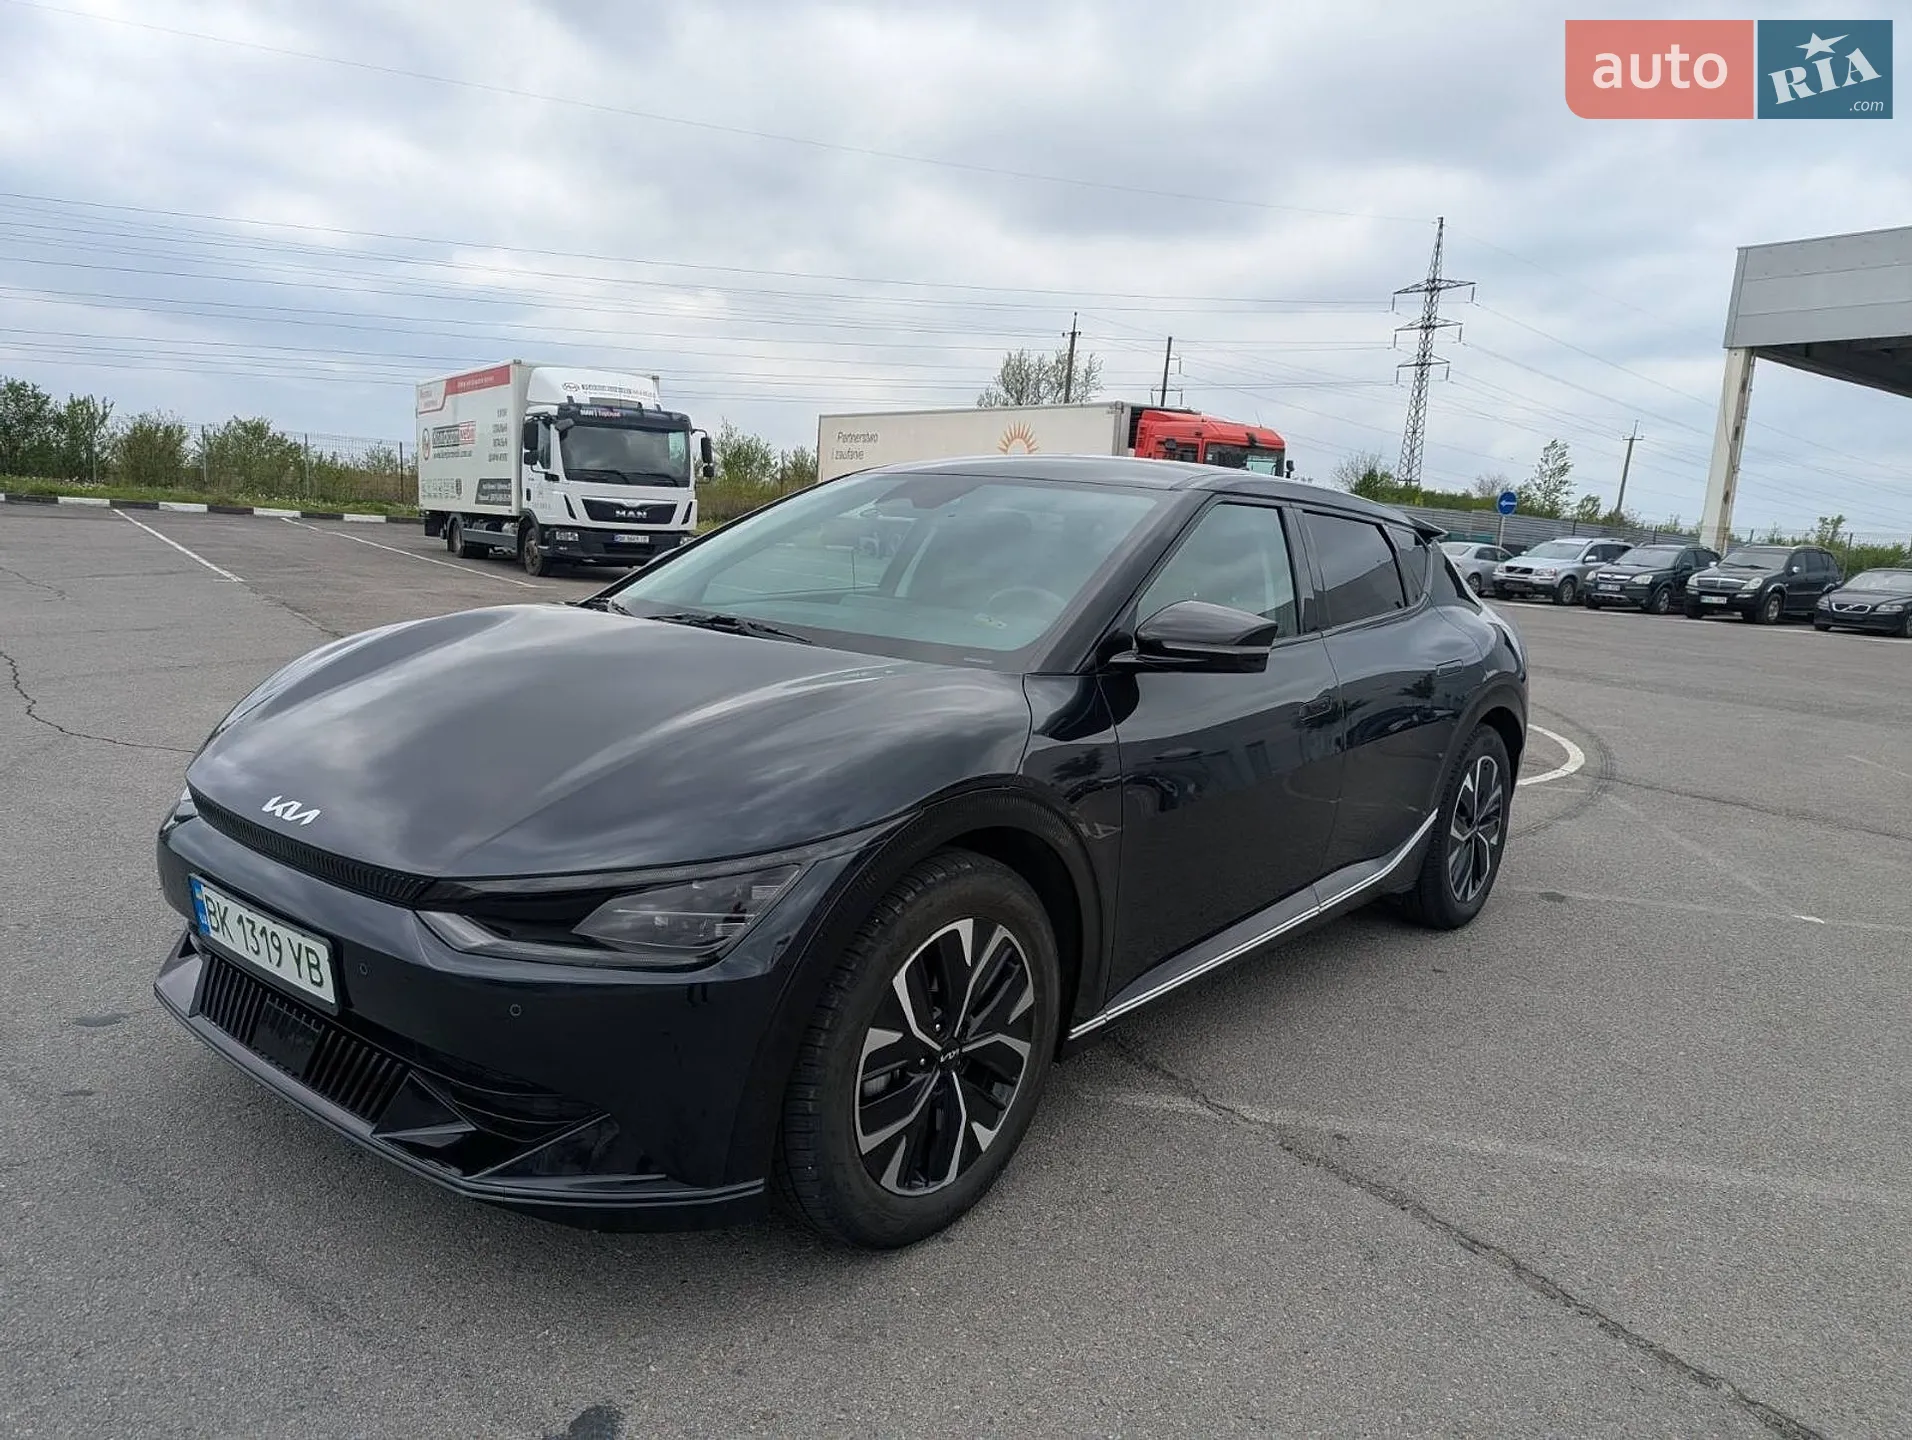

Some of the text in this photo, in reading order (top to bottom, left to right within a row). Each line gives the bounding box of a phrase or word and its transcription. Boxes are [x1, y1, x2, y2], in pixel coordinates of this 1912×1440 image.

[615, 509, 648, 519] MAN
[261, 795, 321, 826] KIA
[204, 893, 325, 988] BK 1319 YB
